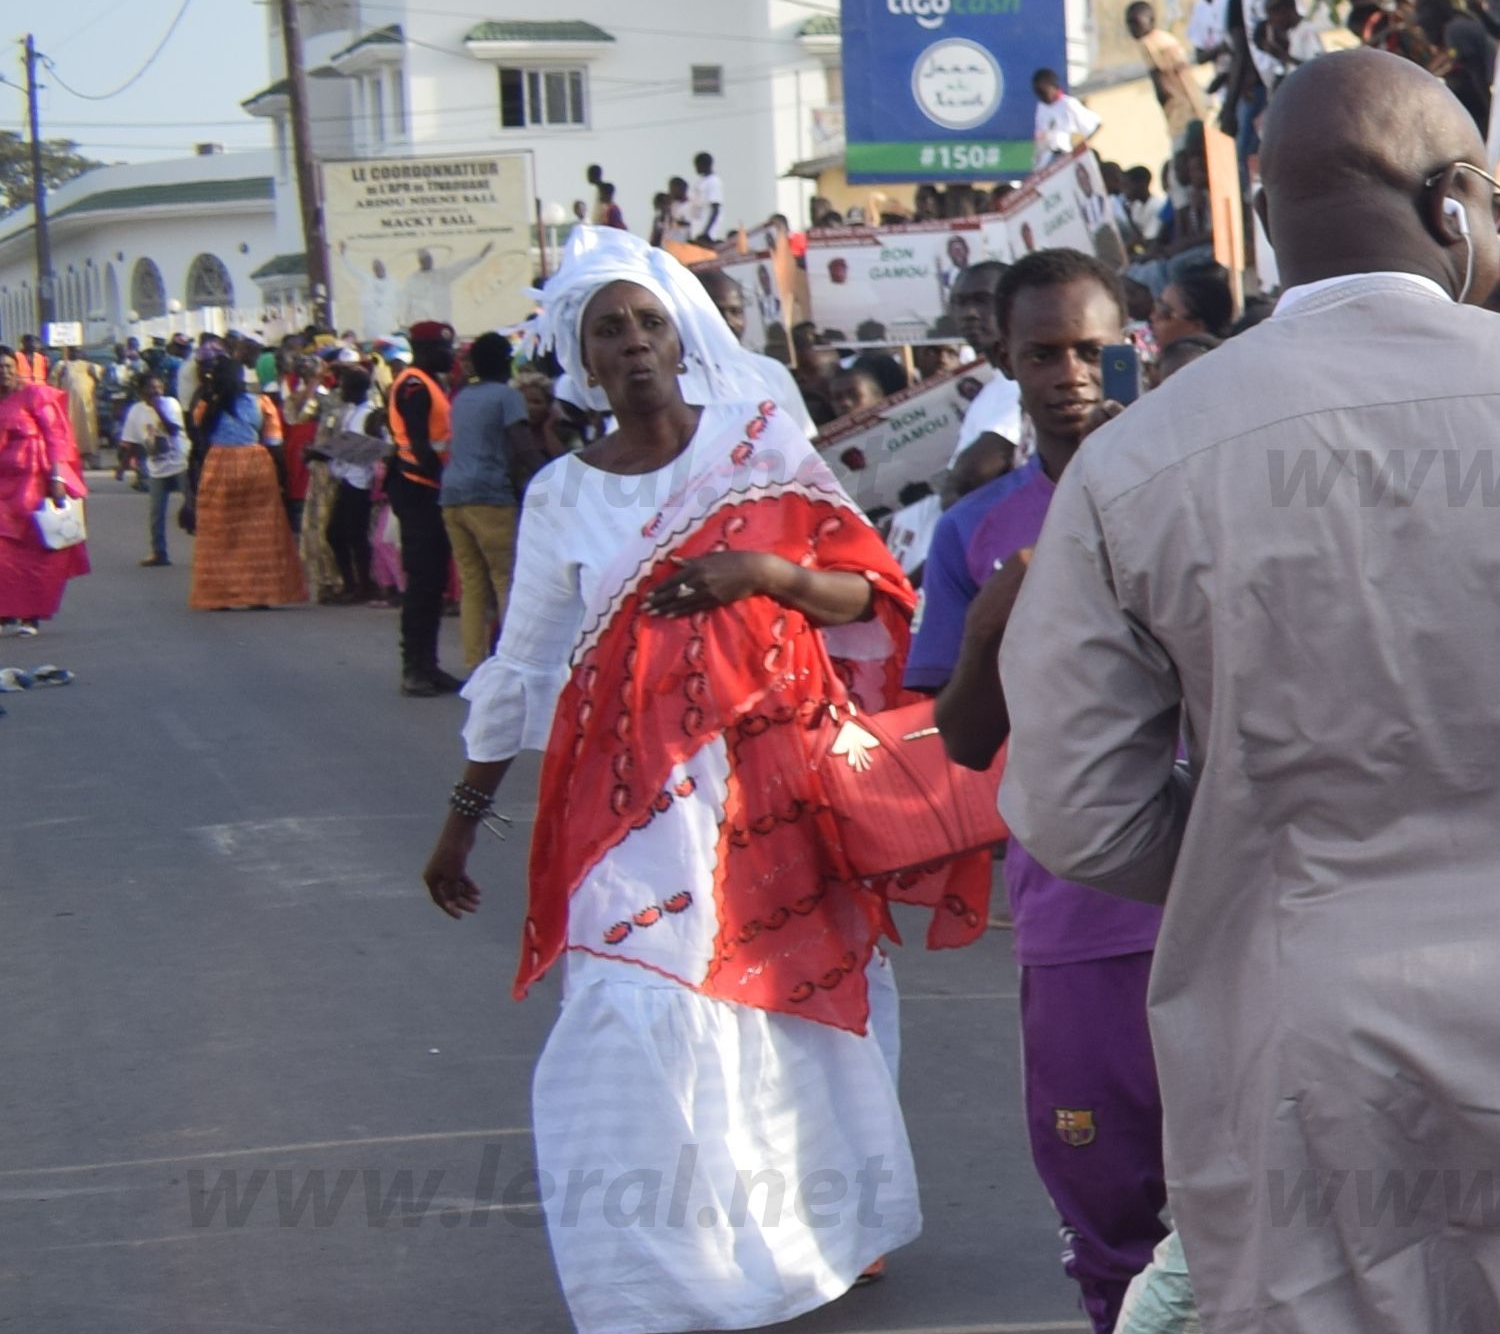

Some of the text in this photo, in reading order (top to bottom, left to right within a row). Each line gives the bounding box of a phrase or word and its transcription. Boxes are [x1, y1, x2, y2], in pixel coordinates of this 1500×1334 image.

[920, 146, 1000, 170] #150#
[881, 248, 914, 261] BON
[870, 267, 928, 280] GAMOU
[890, 407, 927, 431] BON
[888, 415, 948, 452] GAMOU
